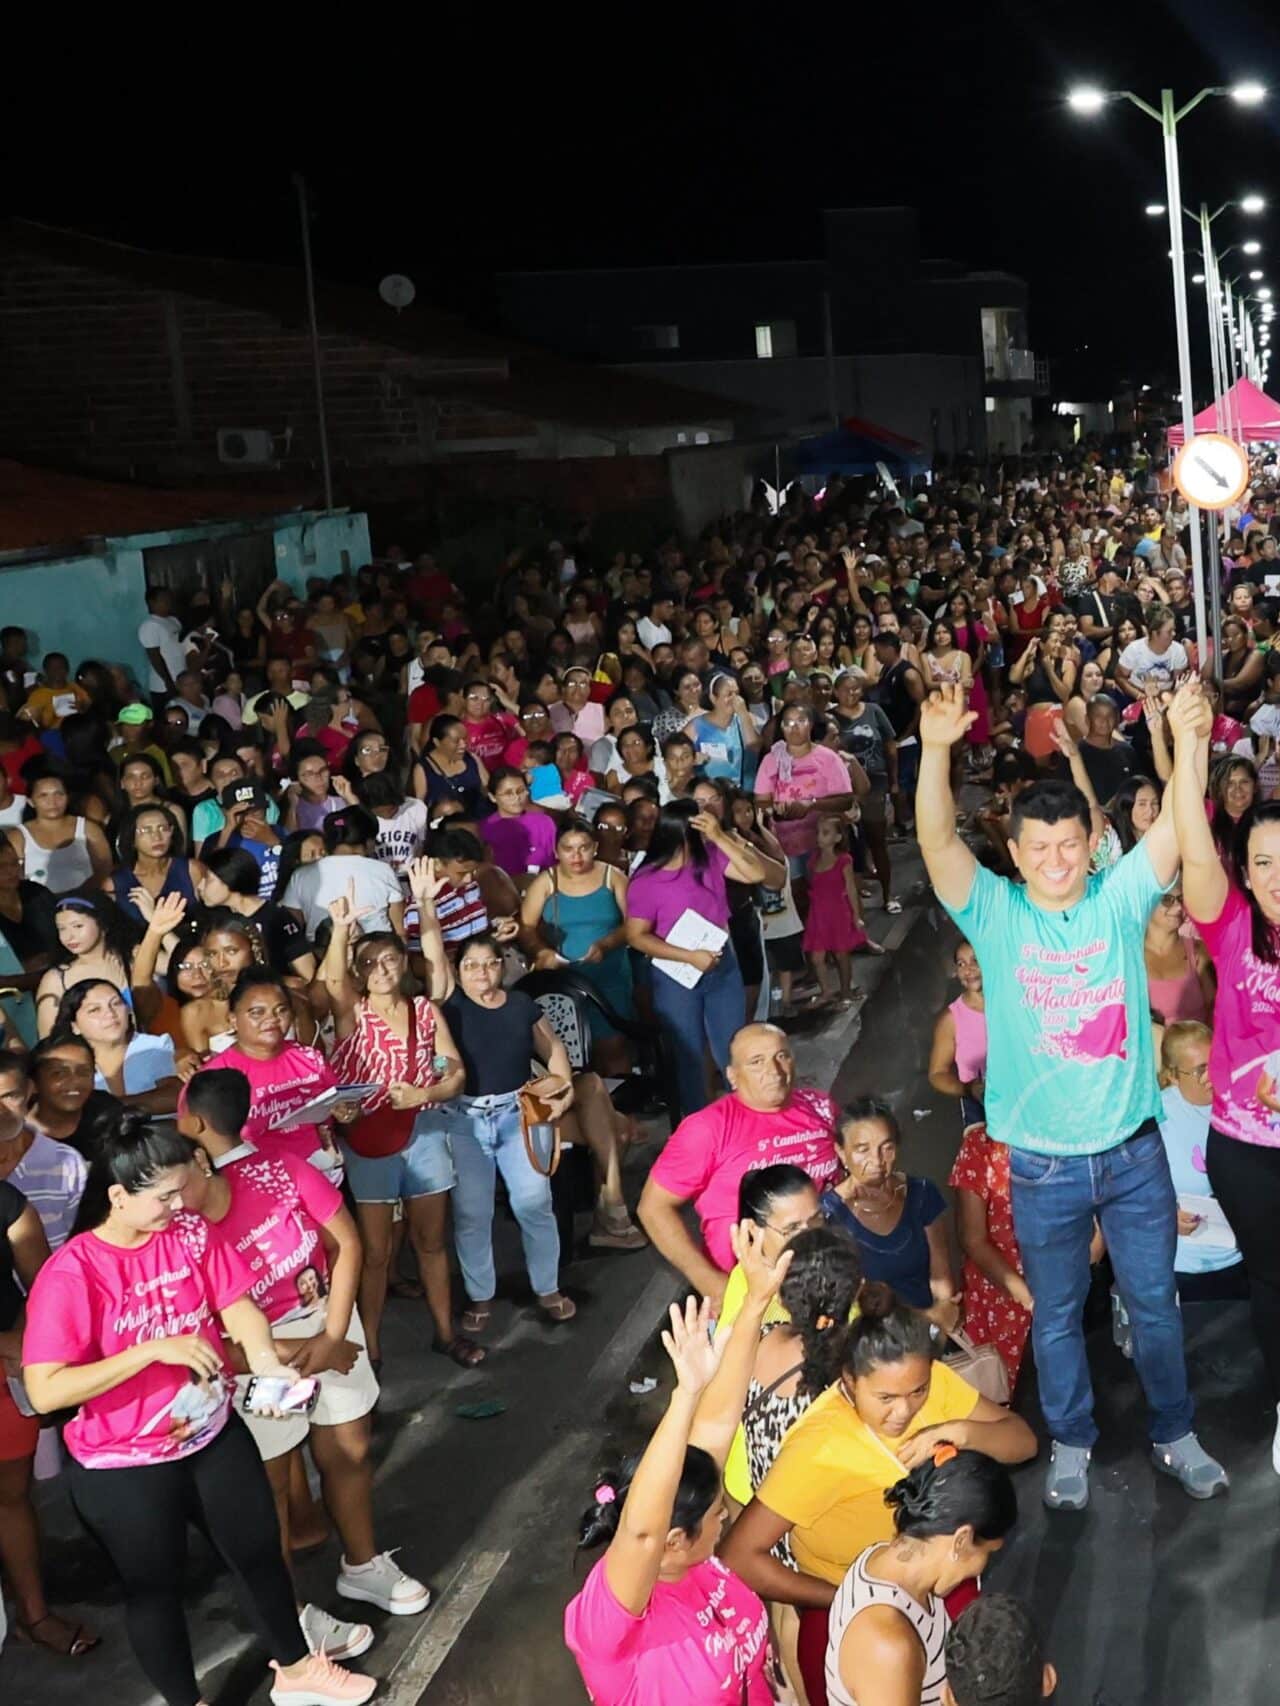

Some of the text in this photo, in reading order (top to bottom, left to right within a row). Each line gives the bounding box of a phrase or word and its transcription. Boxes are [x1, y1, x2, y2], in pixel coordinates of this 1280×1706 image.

[235, 787, 254, 801] CAT
[379, 830, 417, 845] FIGER
[377, 845, 410, 858] ENIM
[267, 1073, 320, 1095] Caminhada
[773, 1129, 828, 1148] Caminhada
[250, 1229, 319, 1302] ovimento
